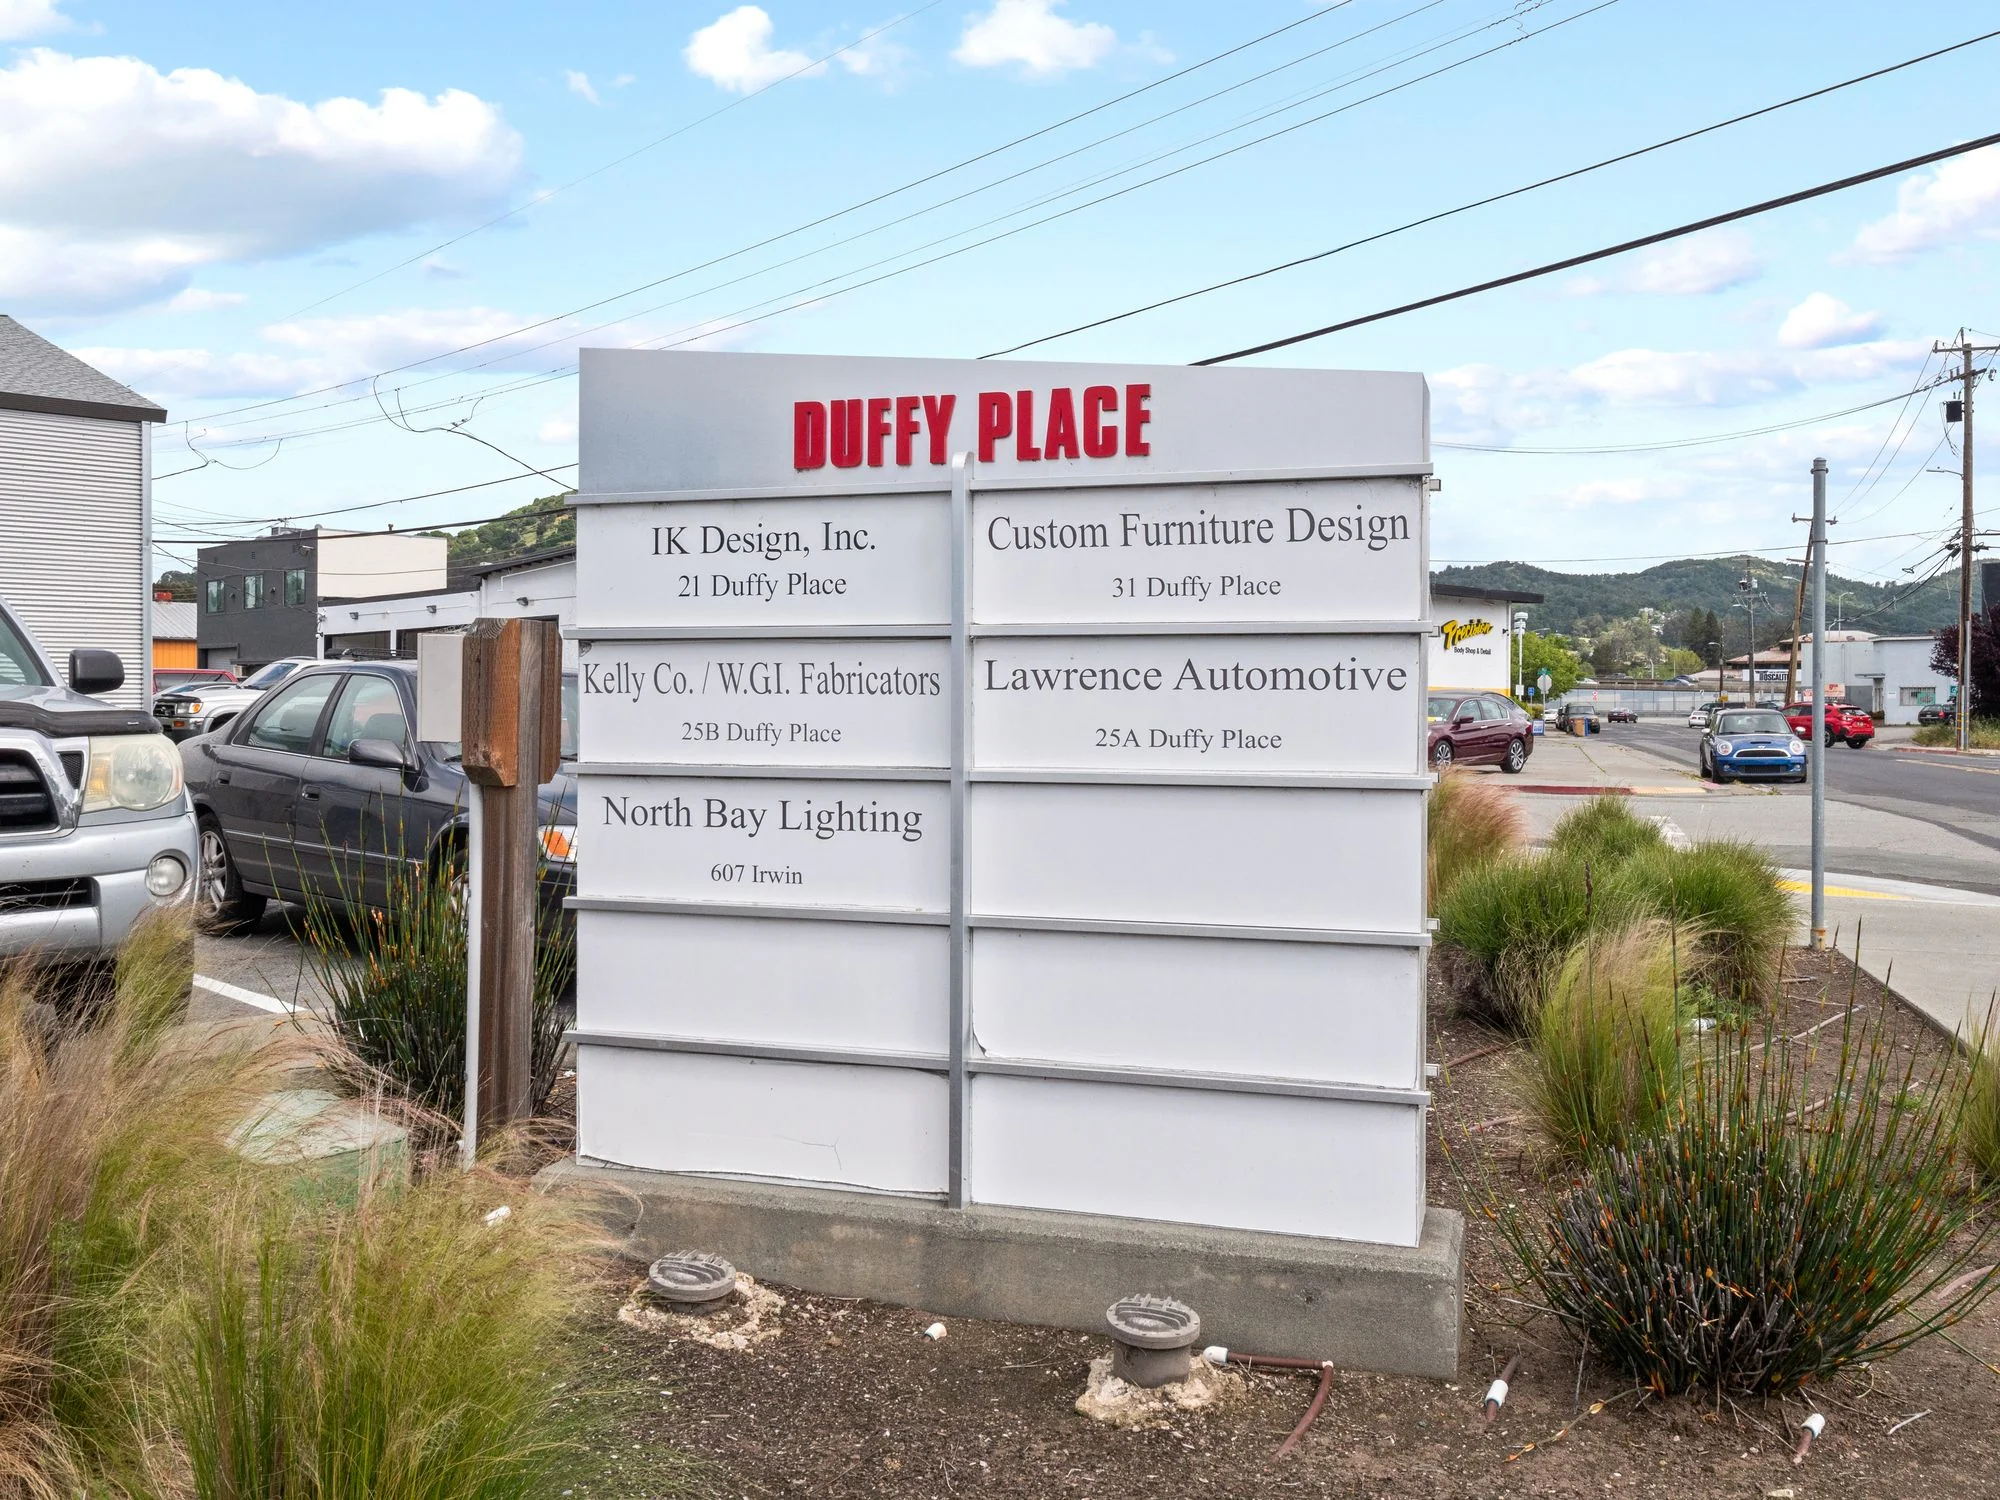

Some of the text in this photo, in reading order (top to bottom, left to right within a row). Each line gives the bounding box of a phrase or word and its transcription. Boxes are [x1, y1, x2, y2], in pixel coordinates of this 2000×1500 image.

[794, 384, 1151, 470] DUFFY PLACE
[651, 522, 876, 561] IK Design, Inc.
[987, 504, 1411, 552] Custom Furniture Design
[678, 572, 847, 603] 21 Duffy Place
[1112, 575, 1281, 602] 31 Duffy Place
[1441, 619, 1494, 650] Precision
[1454, 647, 1465, 655] Body
[1465, 647, 1476, 655] Shop
[583, 662, 646, 703] Kelly
[653, 662, 694, 695] Co.
[702, 661, 710, 695] /
[799, 661, 941, 696] Fabricators
[984, 656, 1407, 692] Lawrence Automotive
[1755, 670, 1788, 681] TOSCALIT
[681, 721, 842, 747] 25B Duffy Place
[1095, 728, 1282, 753] 25A Duffy Place
[601, 796, 923, 842] North Bay Lighting
[710, 863, 803, 885] 607 Irwin
